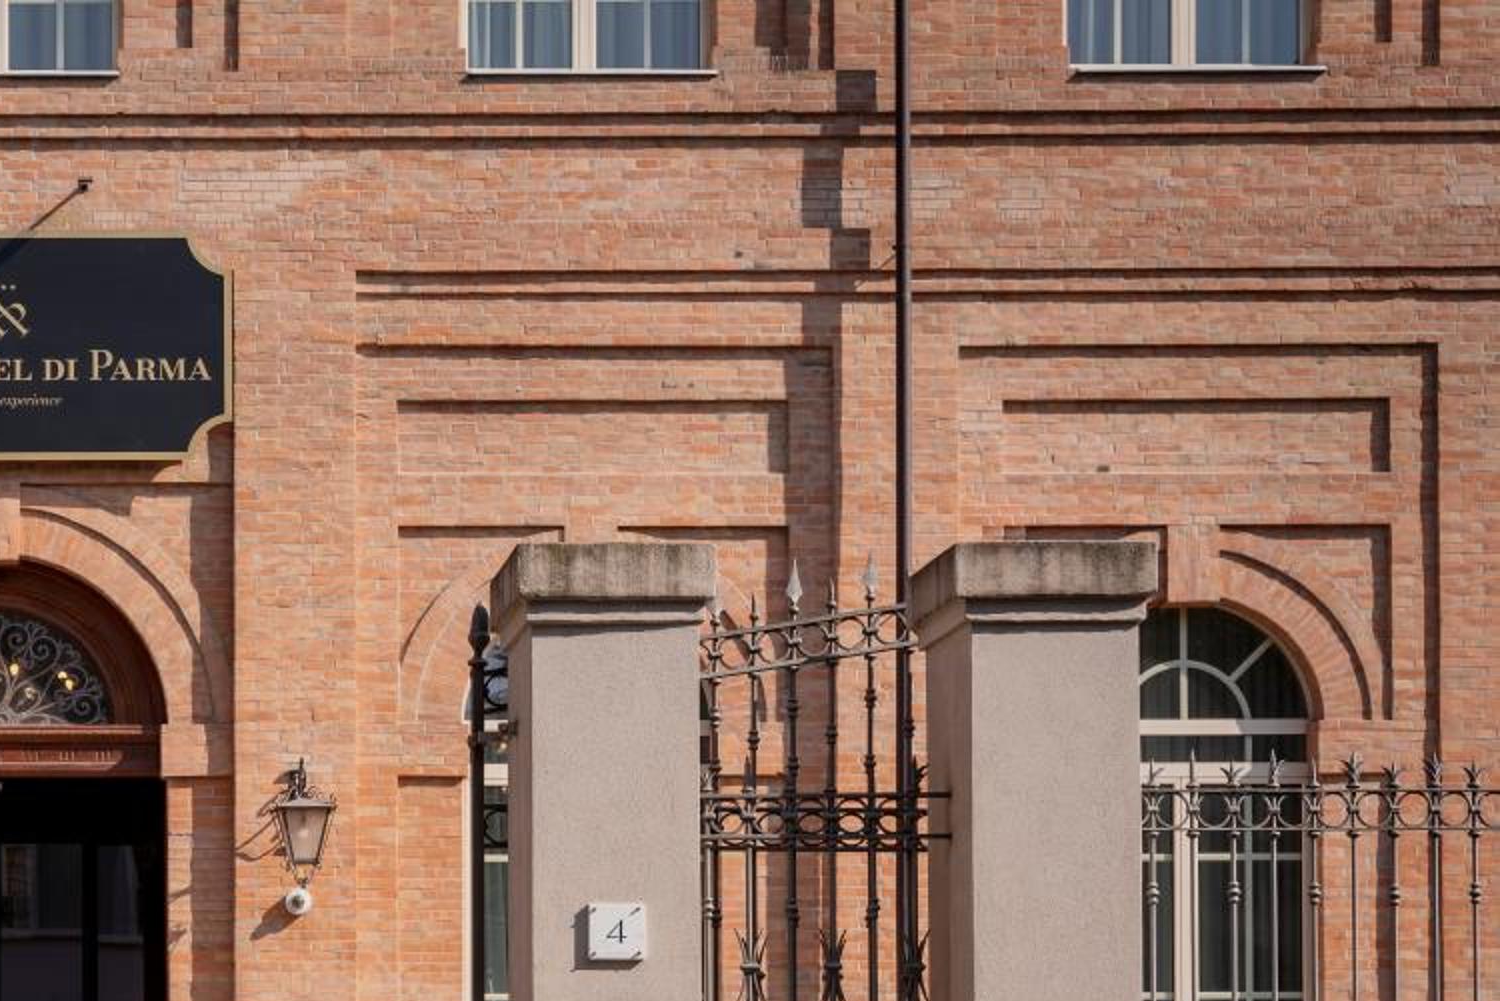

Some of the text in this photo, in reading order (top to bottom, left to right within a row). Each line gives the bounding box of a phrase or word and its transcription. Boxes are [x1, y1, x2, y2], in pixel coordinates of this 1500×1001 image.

[41, 358, 79, 381] DI
[89, 349, 212, 381] PARMA
[0, 393, 62, 409] experience
[605, 919, 628, 944] 4
